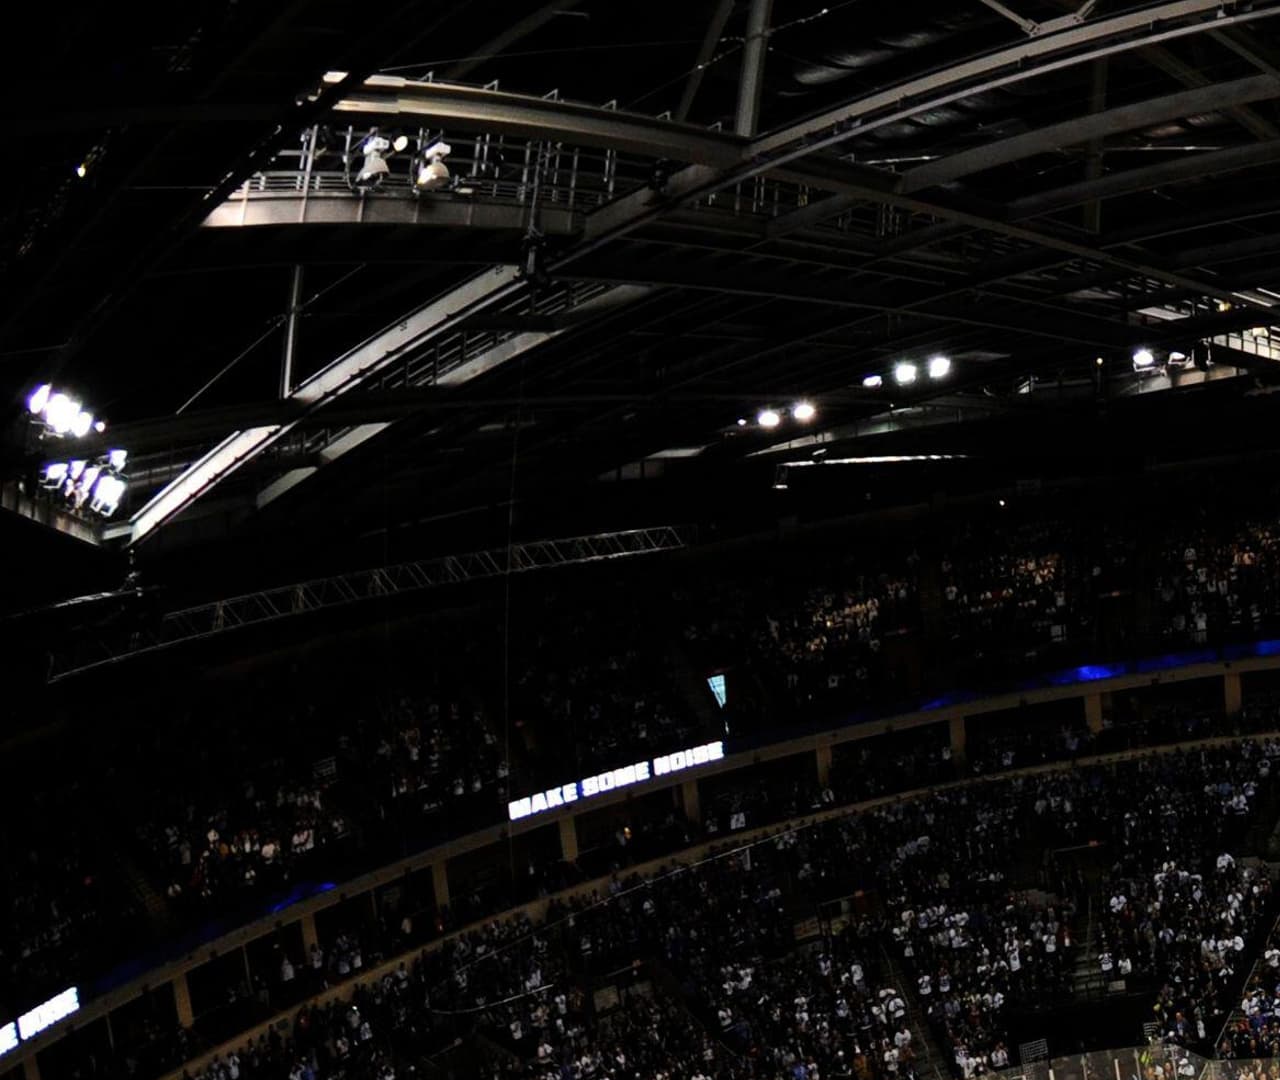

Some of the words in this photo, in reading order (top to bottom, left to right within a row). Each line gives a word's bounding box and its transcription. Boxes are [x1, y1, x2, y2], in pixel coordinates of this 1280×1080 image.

[508, 783, 578, 820] MAKE
[581, 761, 650, 797] SOME
[653, 741, 724, 776] NOISE
